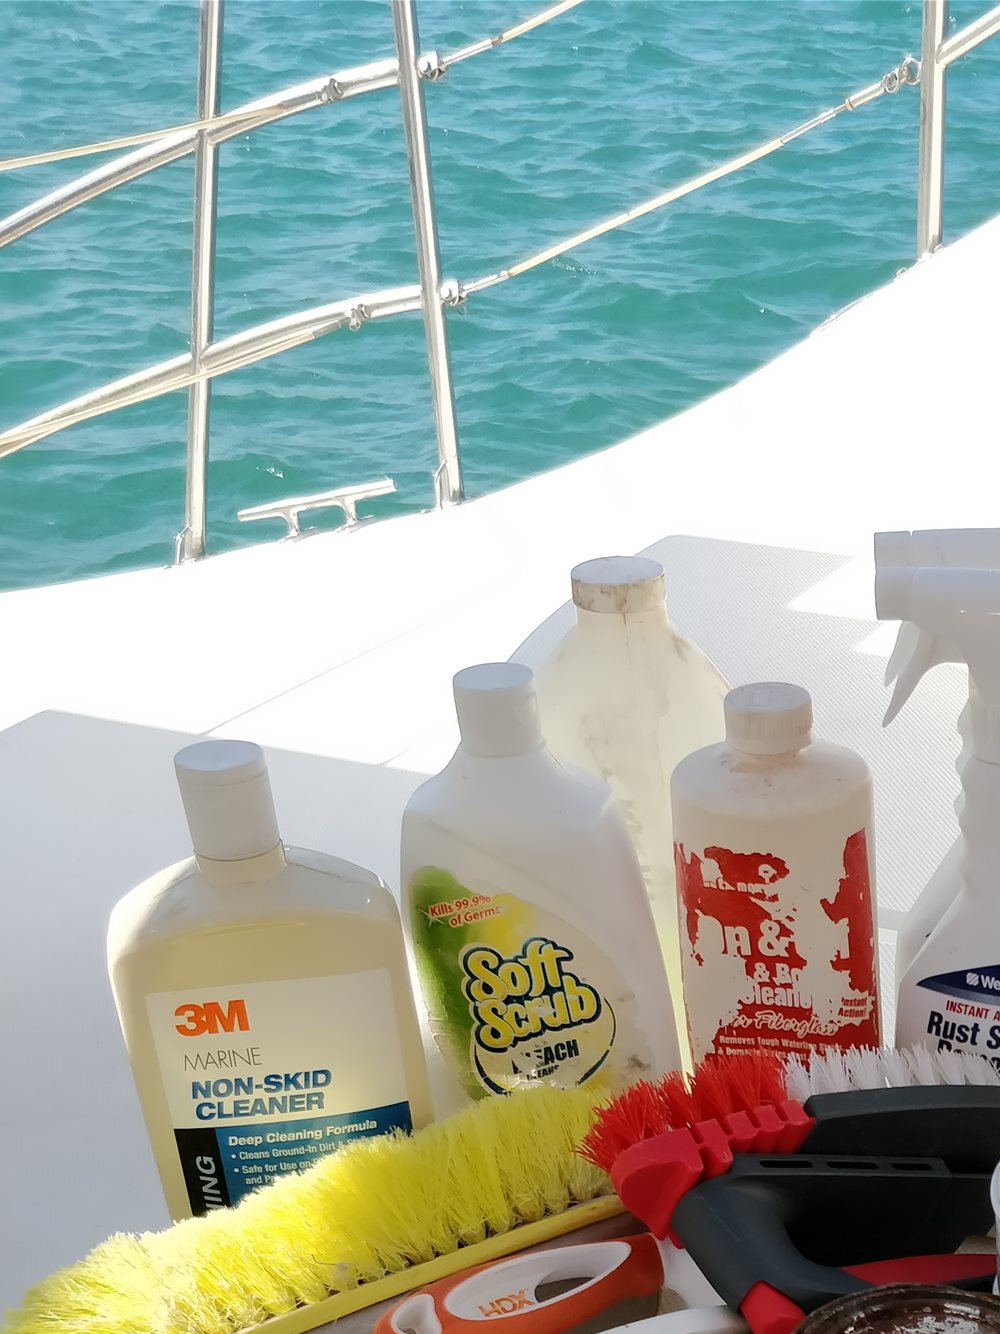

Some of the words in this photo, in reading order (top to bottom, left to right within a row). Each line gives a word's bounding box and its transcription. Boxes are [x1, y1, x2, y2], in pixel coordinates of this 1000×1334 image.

[429, 903, 453, 919] Kills
[454, 895, 491, 912] 99.9%
[450, 913, 462, 927] of
[462, 937, 574, 1003] Soft
[174, 999, 250, 1037] 3M
[472, 972, 602, 1053] Scrub
[946, 1000, 990, 1019] INSTANT
[754, 1010, 840, 1039] Fiberglass
[927, 1011, 980, 1045] Rust
[719, 1035, 755, 1045] Removes
[757, 1036, 779, 1047] Tough
[184, 1047, 263, 1072] MARINE
[191, 1069, 332, 1100] NON-SKID
[195, 1092, 325, 1121] CLEANER
[228, 1134, 263, 1147] Deep
[266, 1128, 323, 1144] Cleaning
[326, 1119, 377, 1136] Formula
[239, 1149, 270, 1160] Cleans
[272, 1143, 317, 1157] Ground-In
[319, 1141, 336, 1152] Dirt
[242, 1164, 263, 1175] Safe
[264, 1163, 278, 1173] for
[280, 1161, 297, 1172] Use
[245, 1176, 262, 1186] and
[478, 1289, 535, 1318] HDX
